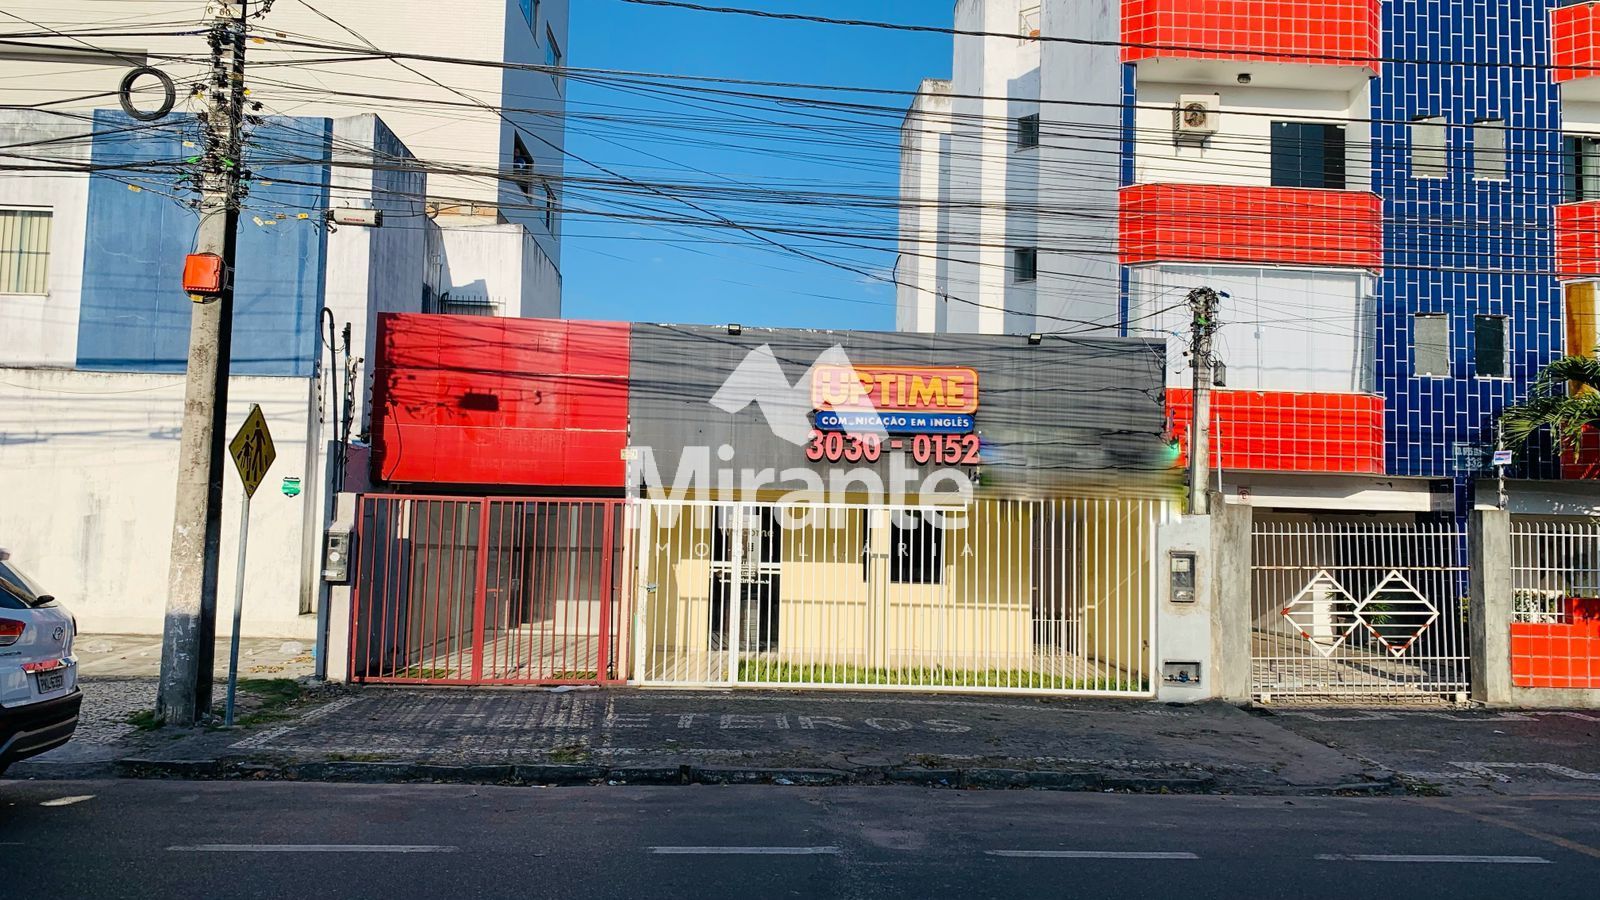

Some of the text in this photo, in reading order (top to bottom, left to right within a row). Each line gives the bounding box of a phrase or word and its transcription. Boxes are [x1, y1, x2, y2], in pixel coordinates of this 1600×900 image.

[821, 371, 966, 407] UPTIME
[821, 415, 970, 430] COMNICAÇÃO EM INGLÊS
[805, 429, 881, 462] 3030
[913, 434, 980, 465] 0152
